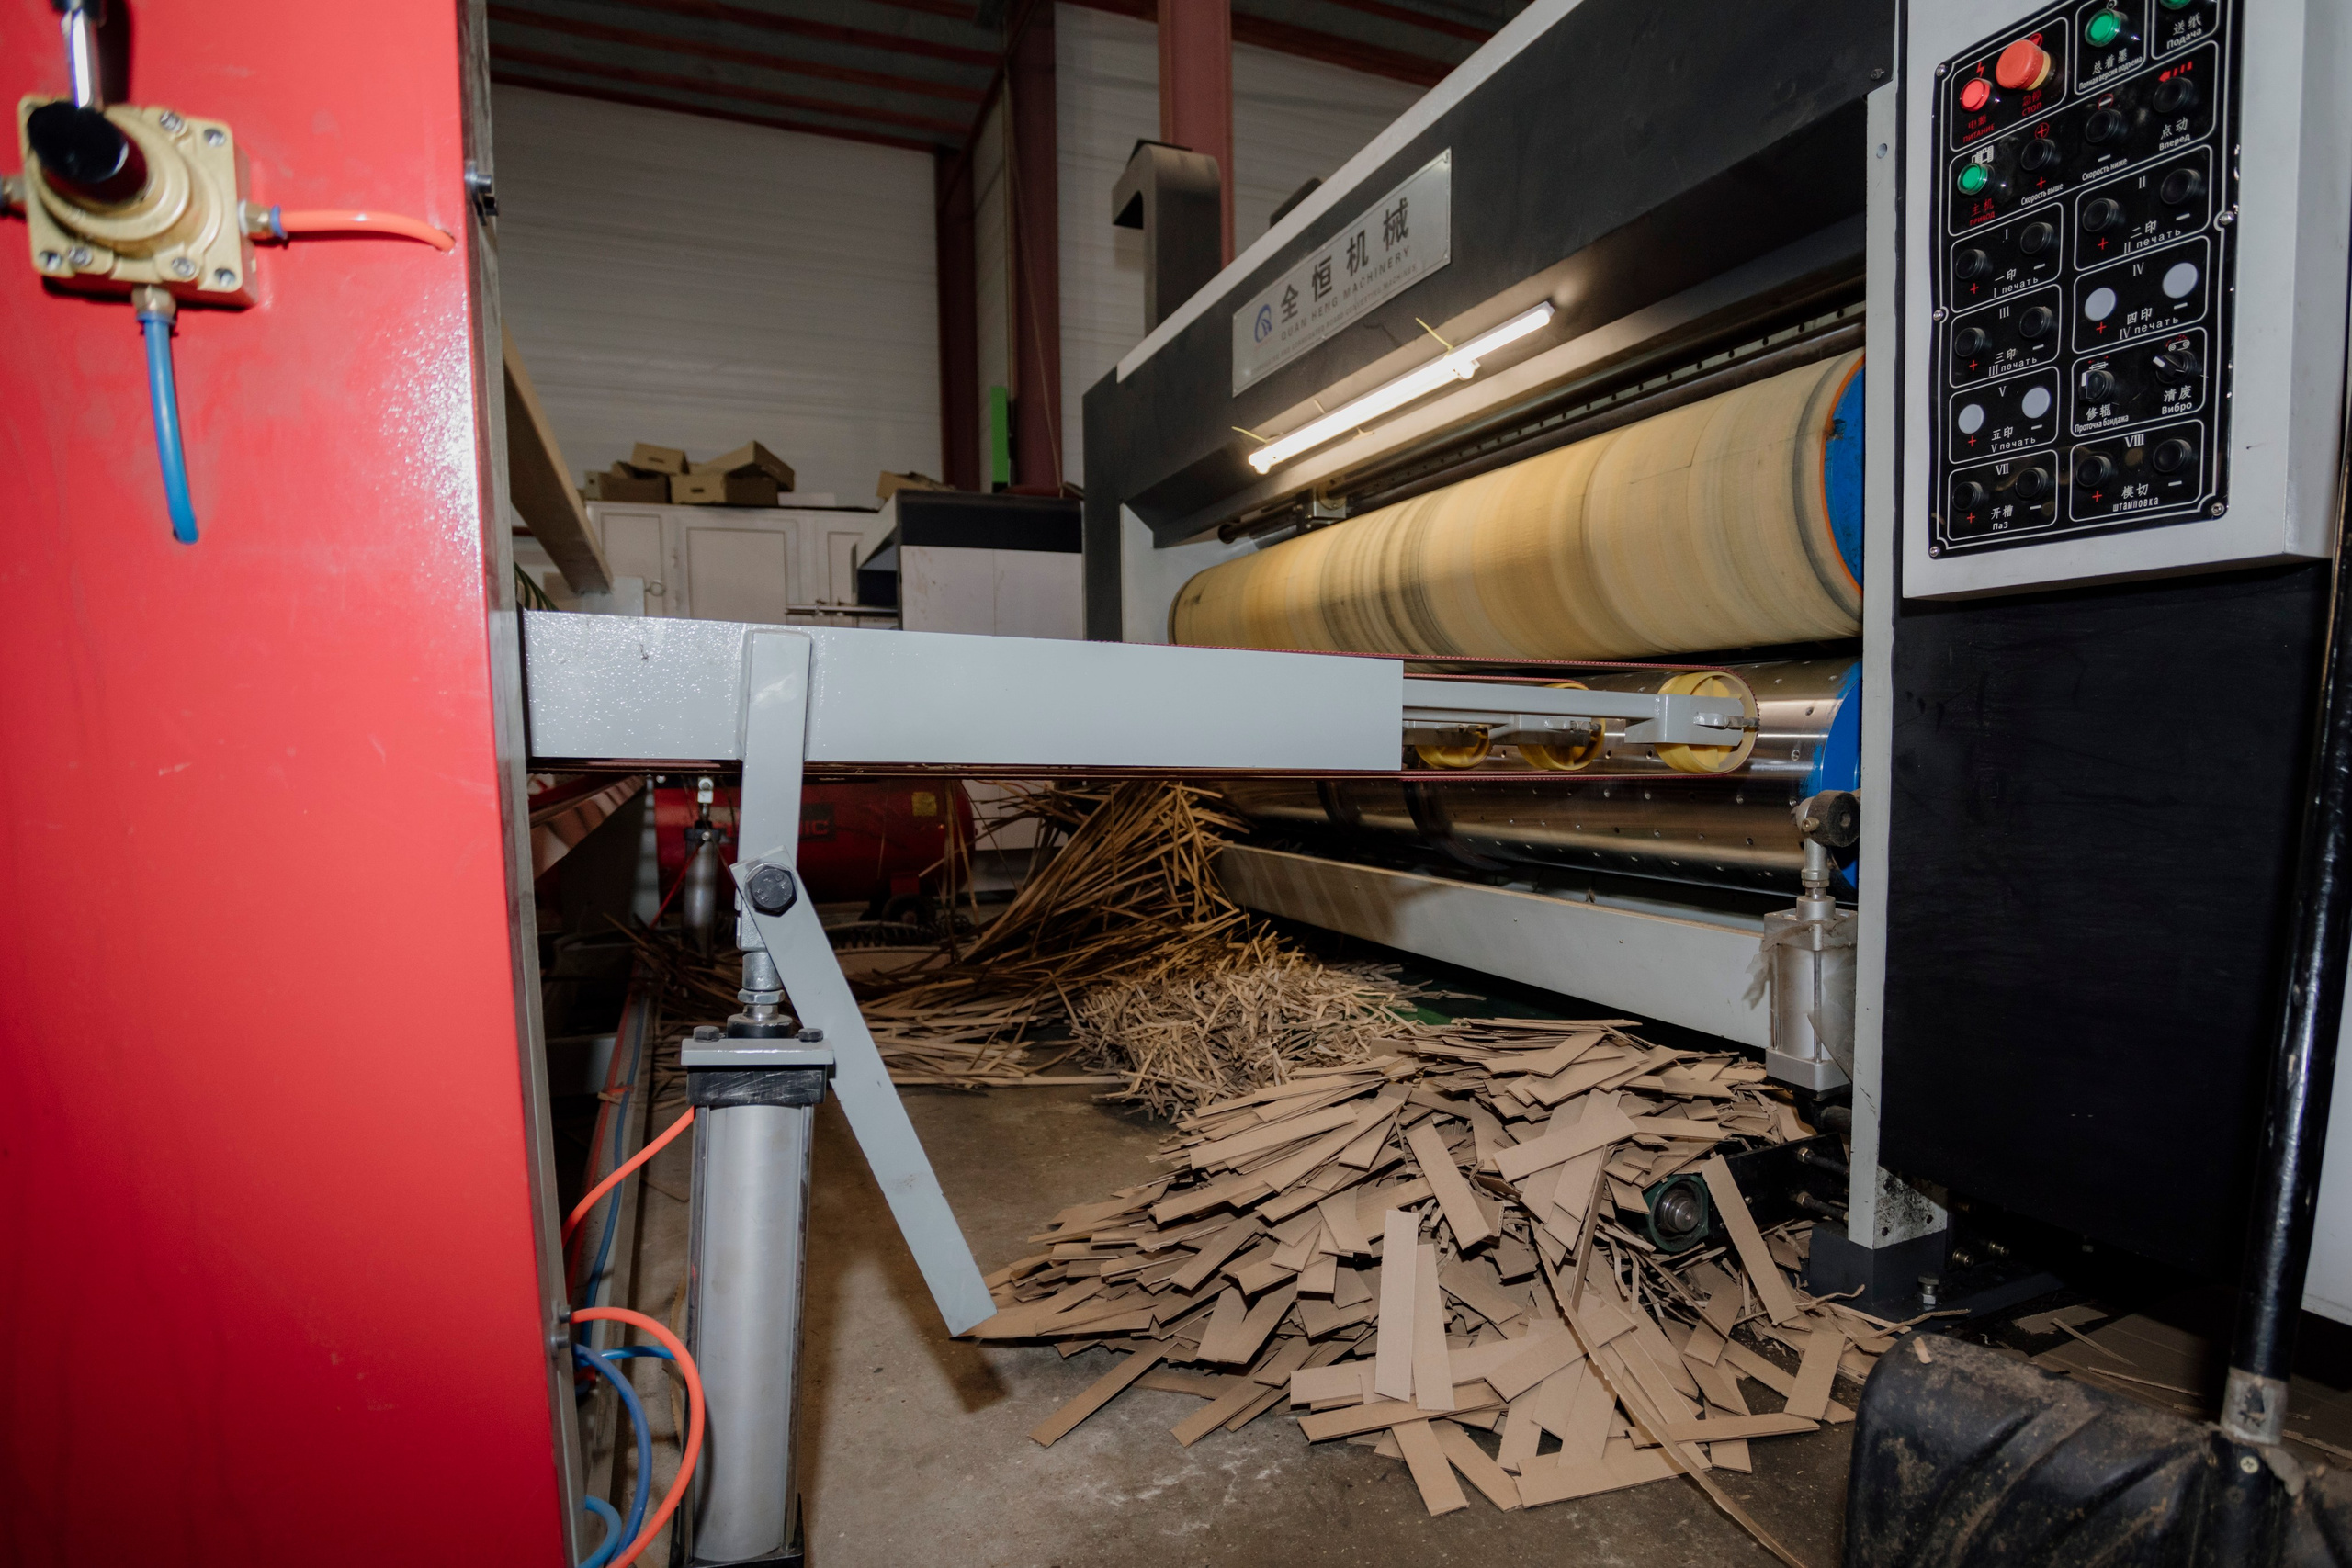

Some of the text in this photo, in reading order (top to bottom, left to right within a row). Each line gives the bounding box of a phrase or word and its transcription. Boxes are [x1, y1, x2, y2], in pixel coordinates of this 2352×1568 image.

[2172, 12, 2202, 36] 送纸
[2166, 28, 2201, 49] Подача
[2092, 48, 2128, 75] 总着墨
[2078, 56, 2143, 91] Полная версия подъема
[2022, 101, 2041, 117] СТОП
[1962, 123, 1995, 143] ПИТАНИЕ
[2160, 117, 2188, 140] 点动
[2159, 133, 2190, 152] Вперед
[2082, 158, 2128, 182] Скорость ниже
[2138, 175, 2146, 189] II
[2021, 184, 2064, 206] Скорость выше
[1971, 198, 1994, 217] 主机
[1970, 211, 1996, 226] ПРИВОД
[2130, 220, 2157, 239] 二印
[2123, 229, 2181, 254] II печать
[1280, 196, 1408, 324] 全恒机械
[1995, 268, 2018, 282] 一印
[2132, 262, 2144, 277] IV
[1281, 246, 1409, 341] QUAN HENG MACHINERY
[2001, 277, 2039, 294] печать
[1999, 306, 2010, 320] III
[2127, 307, 2153, 325] 四印
[2119, 317, 2179, 340] IV печать
[1994, 348, 2016, 365] 三印
[1988, 357, 2038, 377] III печать
[1999, 386, 2007, 397] V
[2163, 385, 2192, 402] 清废
[2086, 404, 2111, 421] 修辊
[2161, 401, 2192, 415] Вибро
[2075, 415, 2130, 434] Проточка бандажа
[1991, 426, 2014, 441] 五印
[2124, 434, 2145, 448] VIII
[1990, 436, 2036, 453] V печать
[1996, 463, 2009, 476] VII
[2121, 483, 2149, 500] 模切
[1990, 505, 2014, 520] 开槽
[2113, 496, 2159, 513] штамповка
